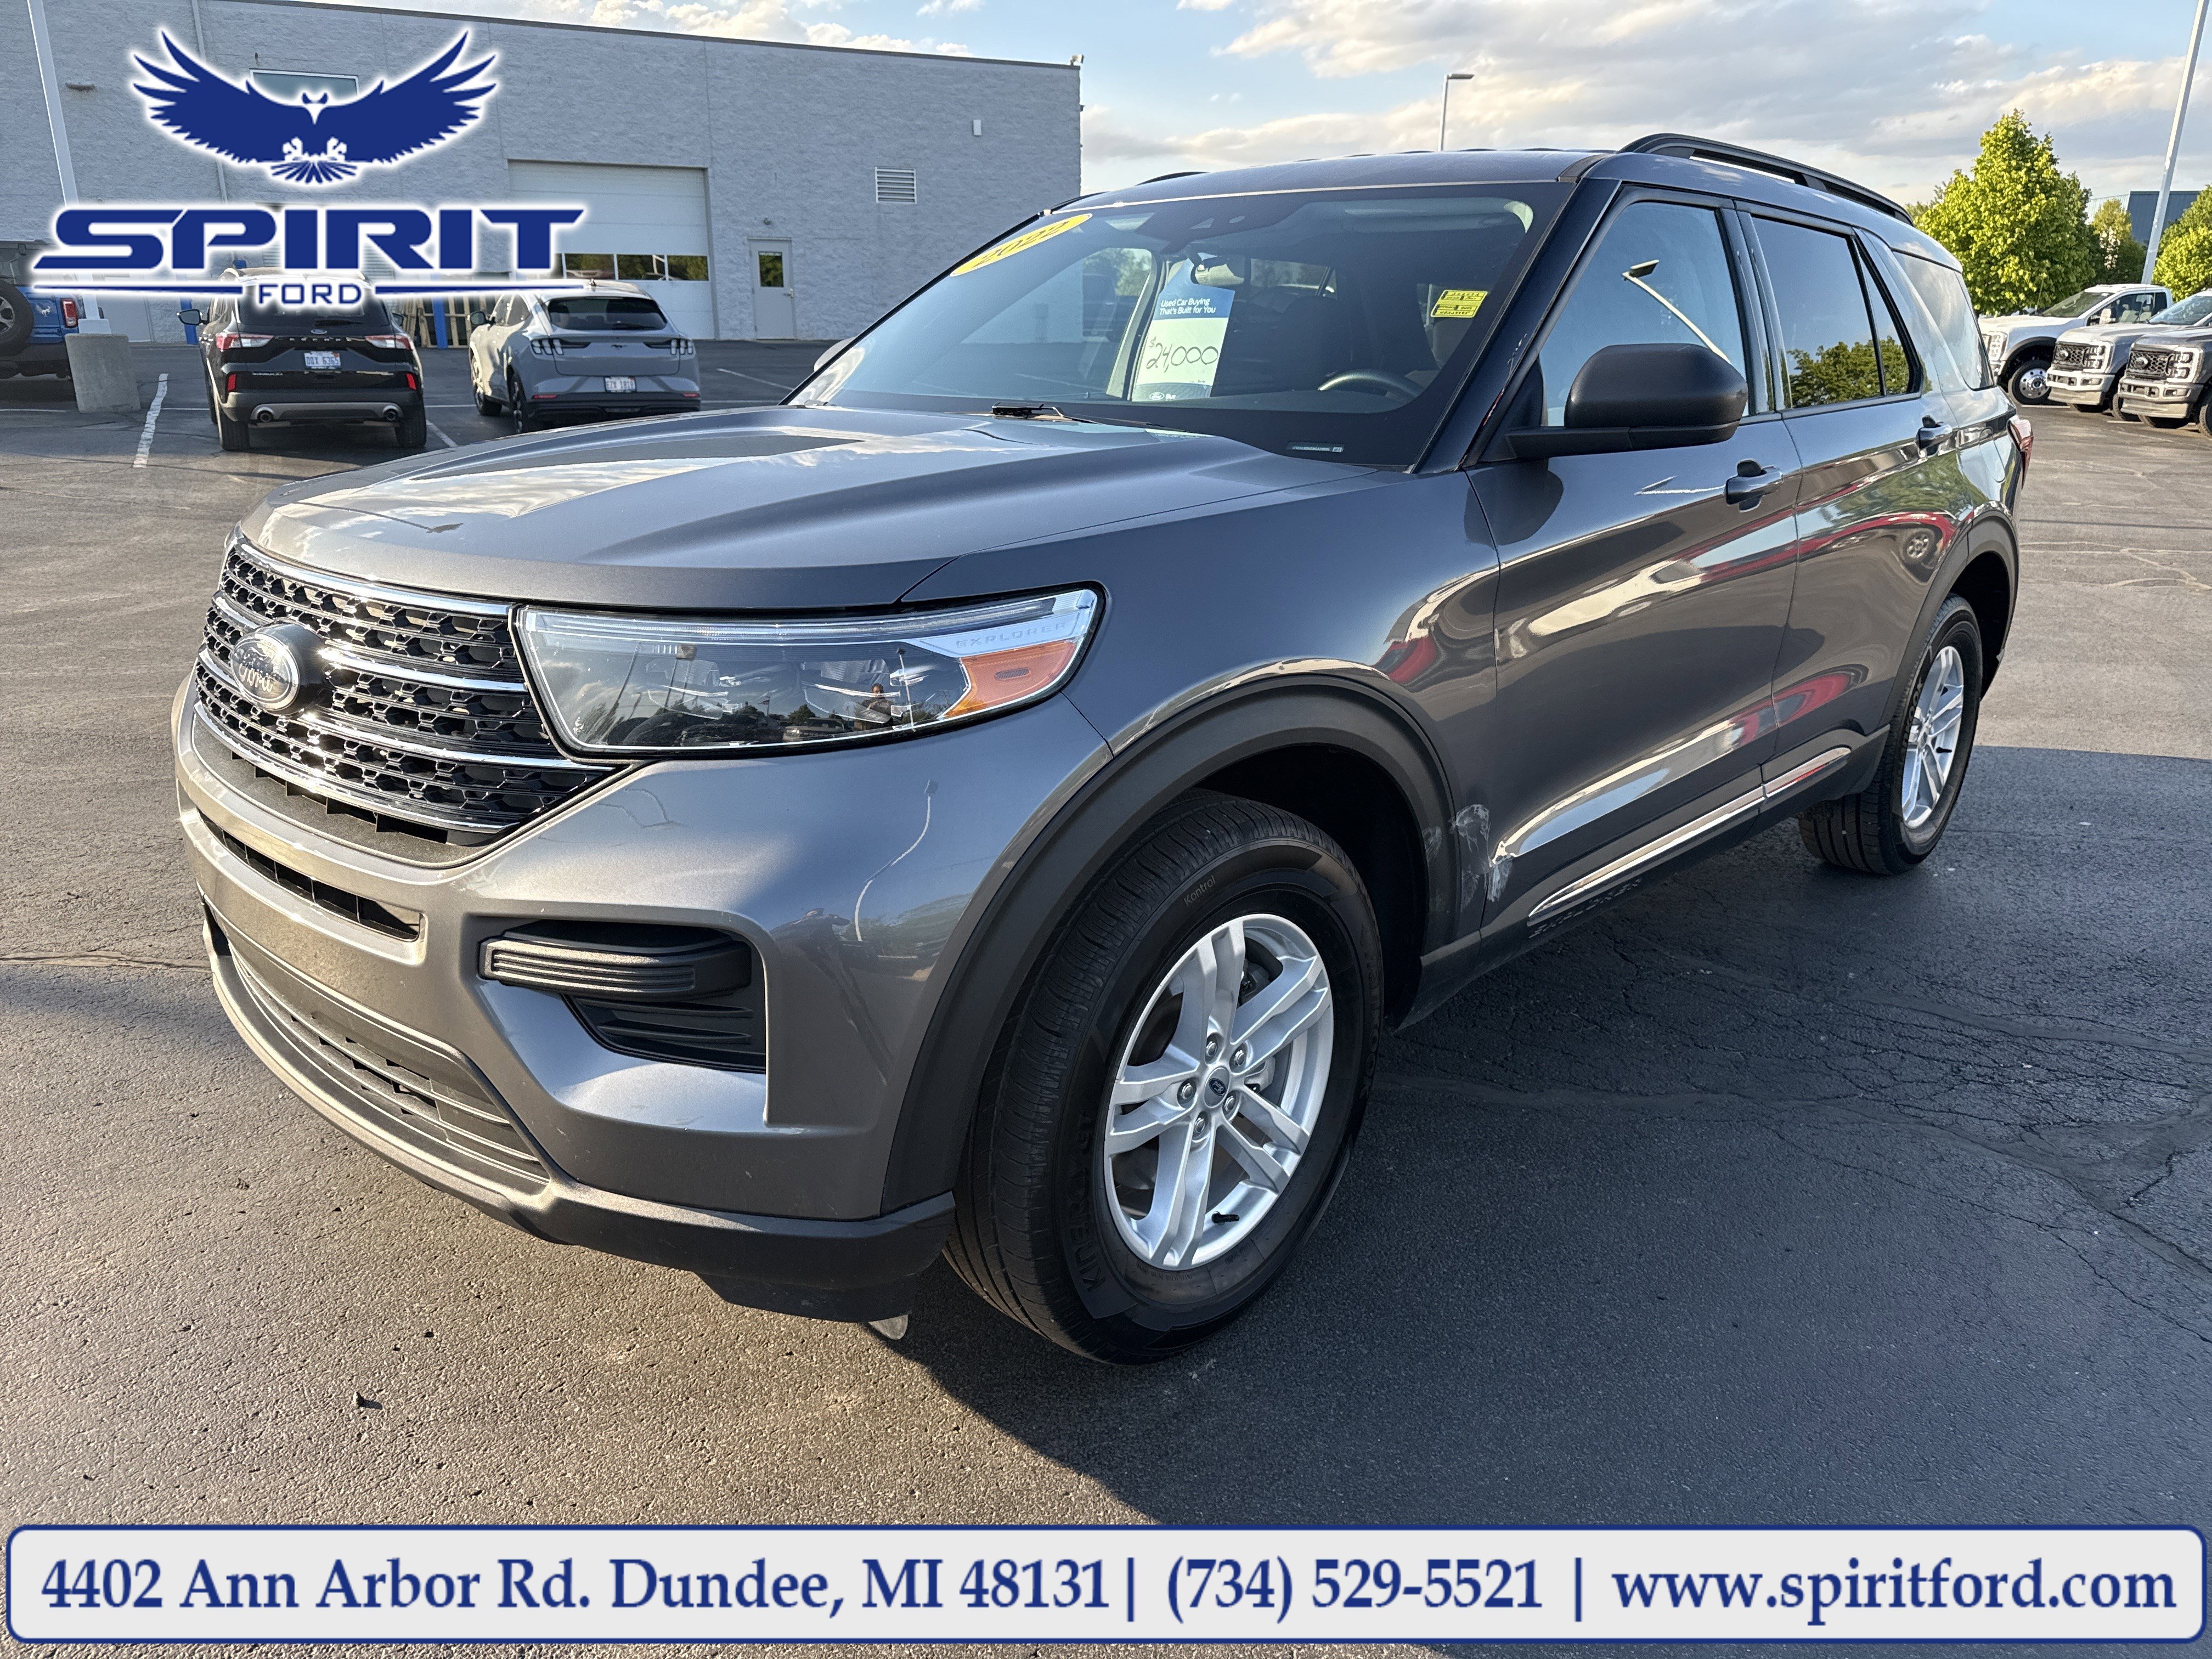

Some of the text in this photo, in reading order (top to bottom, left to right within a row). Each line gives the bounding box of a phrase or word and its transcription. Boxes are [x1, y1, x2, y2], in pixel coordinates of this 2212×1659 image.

[972, 222, 1069, 267] 2022
[1159, 307, 1177, 315] That's
[1178, 306, 1193, 315] Built
[1160, 297, 1211, 308] Used Car Buying
[956, 622, 1066, 648] EXPLORER
[1183, 875, 1216, 907] Kontrol
